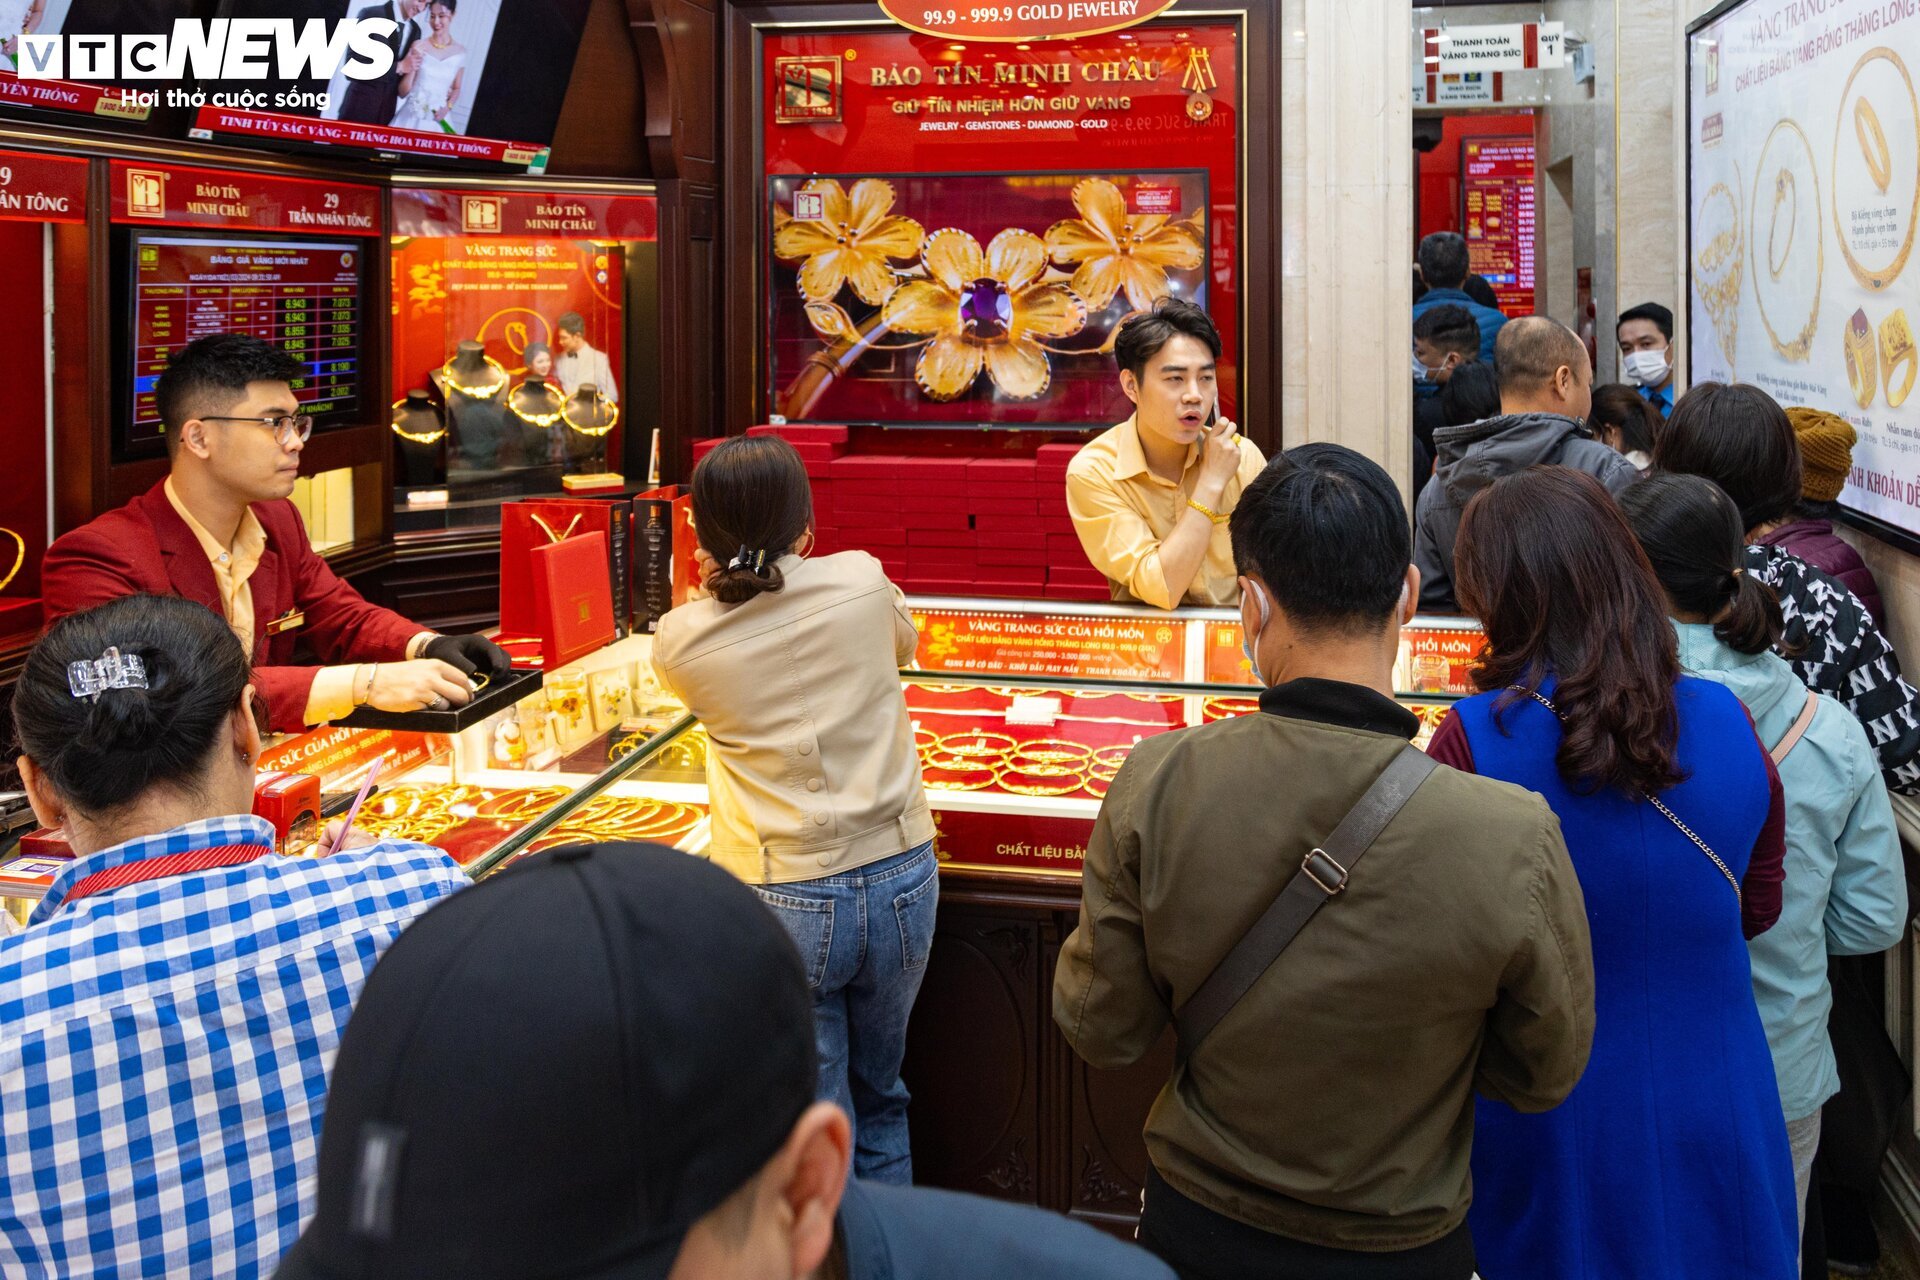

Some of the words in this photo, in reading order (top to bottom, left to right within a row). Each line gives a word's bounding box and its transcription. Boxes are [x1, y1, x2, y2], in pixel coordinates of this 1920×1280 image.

[923, 9, 956, 26] 99.9
[970, 7, 1013, 23] 999.9
[1016, 4, 1063, 21] GOLD
[1066, 0, 1139, 21] JEWELRY
[1844, 9, 1880, 45] THĂNG
[1882, 0, 1915, 29] LONG
[1452, 39, 1483, 47] THANH
[1485, 37, 1510, 45] TOÁN
[1547, 44, 1553, 55] 1
[1441, 49, 1468, 60] VÀNG
[1470, 50, 1501, 58] TRANG
[1503, 48, 1521, 57] SỨC
[870, 62, 922, 87] BẢO
[933, 60, 983, 85] TÍN
[993, 62, 1072, 84] MINH
[1081, 56, 1162, 83] CHÂU
[891, 96, 920, 114] GIỮ
[928, 96, 952, 113] TÍN
[956, 96, 1004, 117] NHIỆM
[1009, 95, 1045, 111] HƠN
[1049, 94, 1081, 111] GIỮ
[1085, 95, 1131, 110] VÀNG
[220, 115, 253, 129] TINH
[308, 124, 341, 139] VÀNG
[350, 130, 388, 144] THĂNG
[389, 135, 413, 146] HOA
[415, 138, 455, 152] TRUYỀN
[919, 120, 959, 131] JEWELRY
[965, 120, 1021, 131] GEMSTONES
[1028, 119, 1075, 130] DIAMOND
[1080, 119, 1108, 129] GOLD
[0, 166, 12, 186] 9
[195, 182, 221, 198] BẢO
[221, 184, 241, 199] TÍN
[25, 191, 69, 212] TÔNG
[186, 201, 217, 215] MINH
[219, 202, 250, 217] CHÂU
[323, 193, 340, 209] 29
[288, 206, 315, 224] TRẦN
[316, 209, 345, 226] NHÂN
[347, 212, 372, 228] TÔNG
[535, 203, 563, 216] BẢO
[564, 203, 586, 217] TÍN
[525, 218, 560, 230] MINH
[561, 217, 597, 231] CHÂU
[464, 243, 496, 256] VÀNG
[498, 245, 535, 257] TRANG
[535, 243, 558, 257] SỨC
[1867, 469, 1903, 503] KHOẢN
[968, 619, 1001, 632] VÀNG
[1004, 622, 1042, 634] TRANG
[1044, 623, 1066, 636] SỨC
[1067, 623, 1091, 637] CỦA
[1094, 623, 1114, 638] HỒI
[1117, 627, 1145, 640] MÔN
[1013, 634, 1033, 646] VÀNG
[1056, 638, 1080, 649] THĂNG
[1081, 641, 1101, 650] LONG
[1415, 636, 1438, 652] HỒI
[1441, 639, 1471, 653] MÔN
[1045, 664, 1061, 673] MAY
[1086, 667, 1110, 676] THANH
[279, 747, 304, 769] SỨC
[304, 736, 329, 757] CỦA
[996, 841, 1031, 856] CHẤT
[1033, 844, 1062, 860] LIỆU
